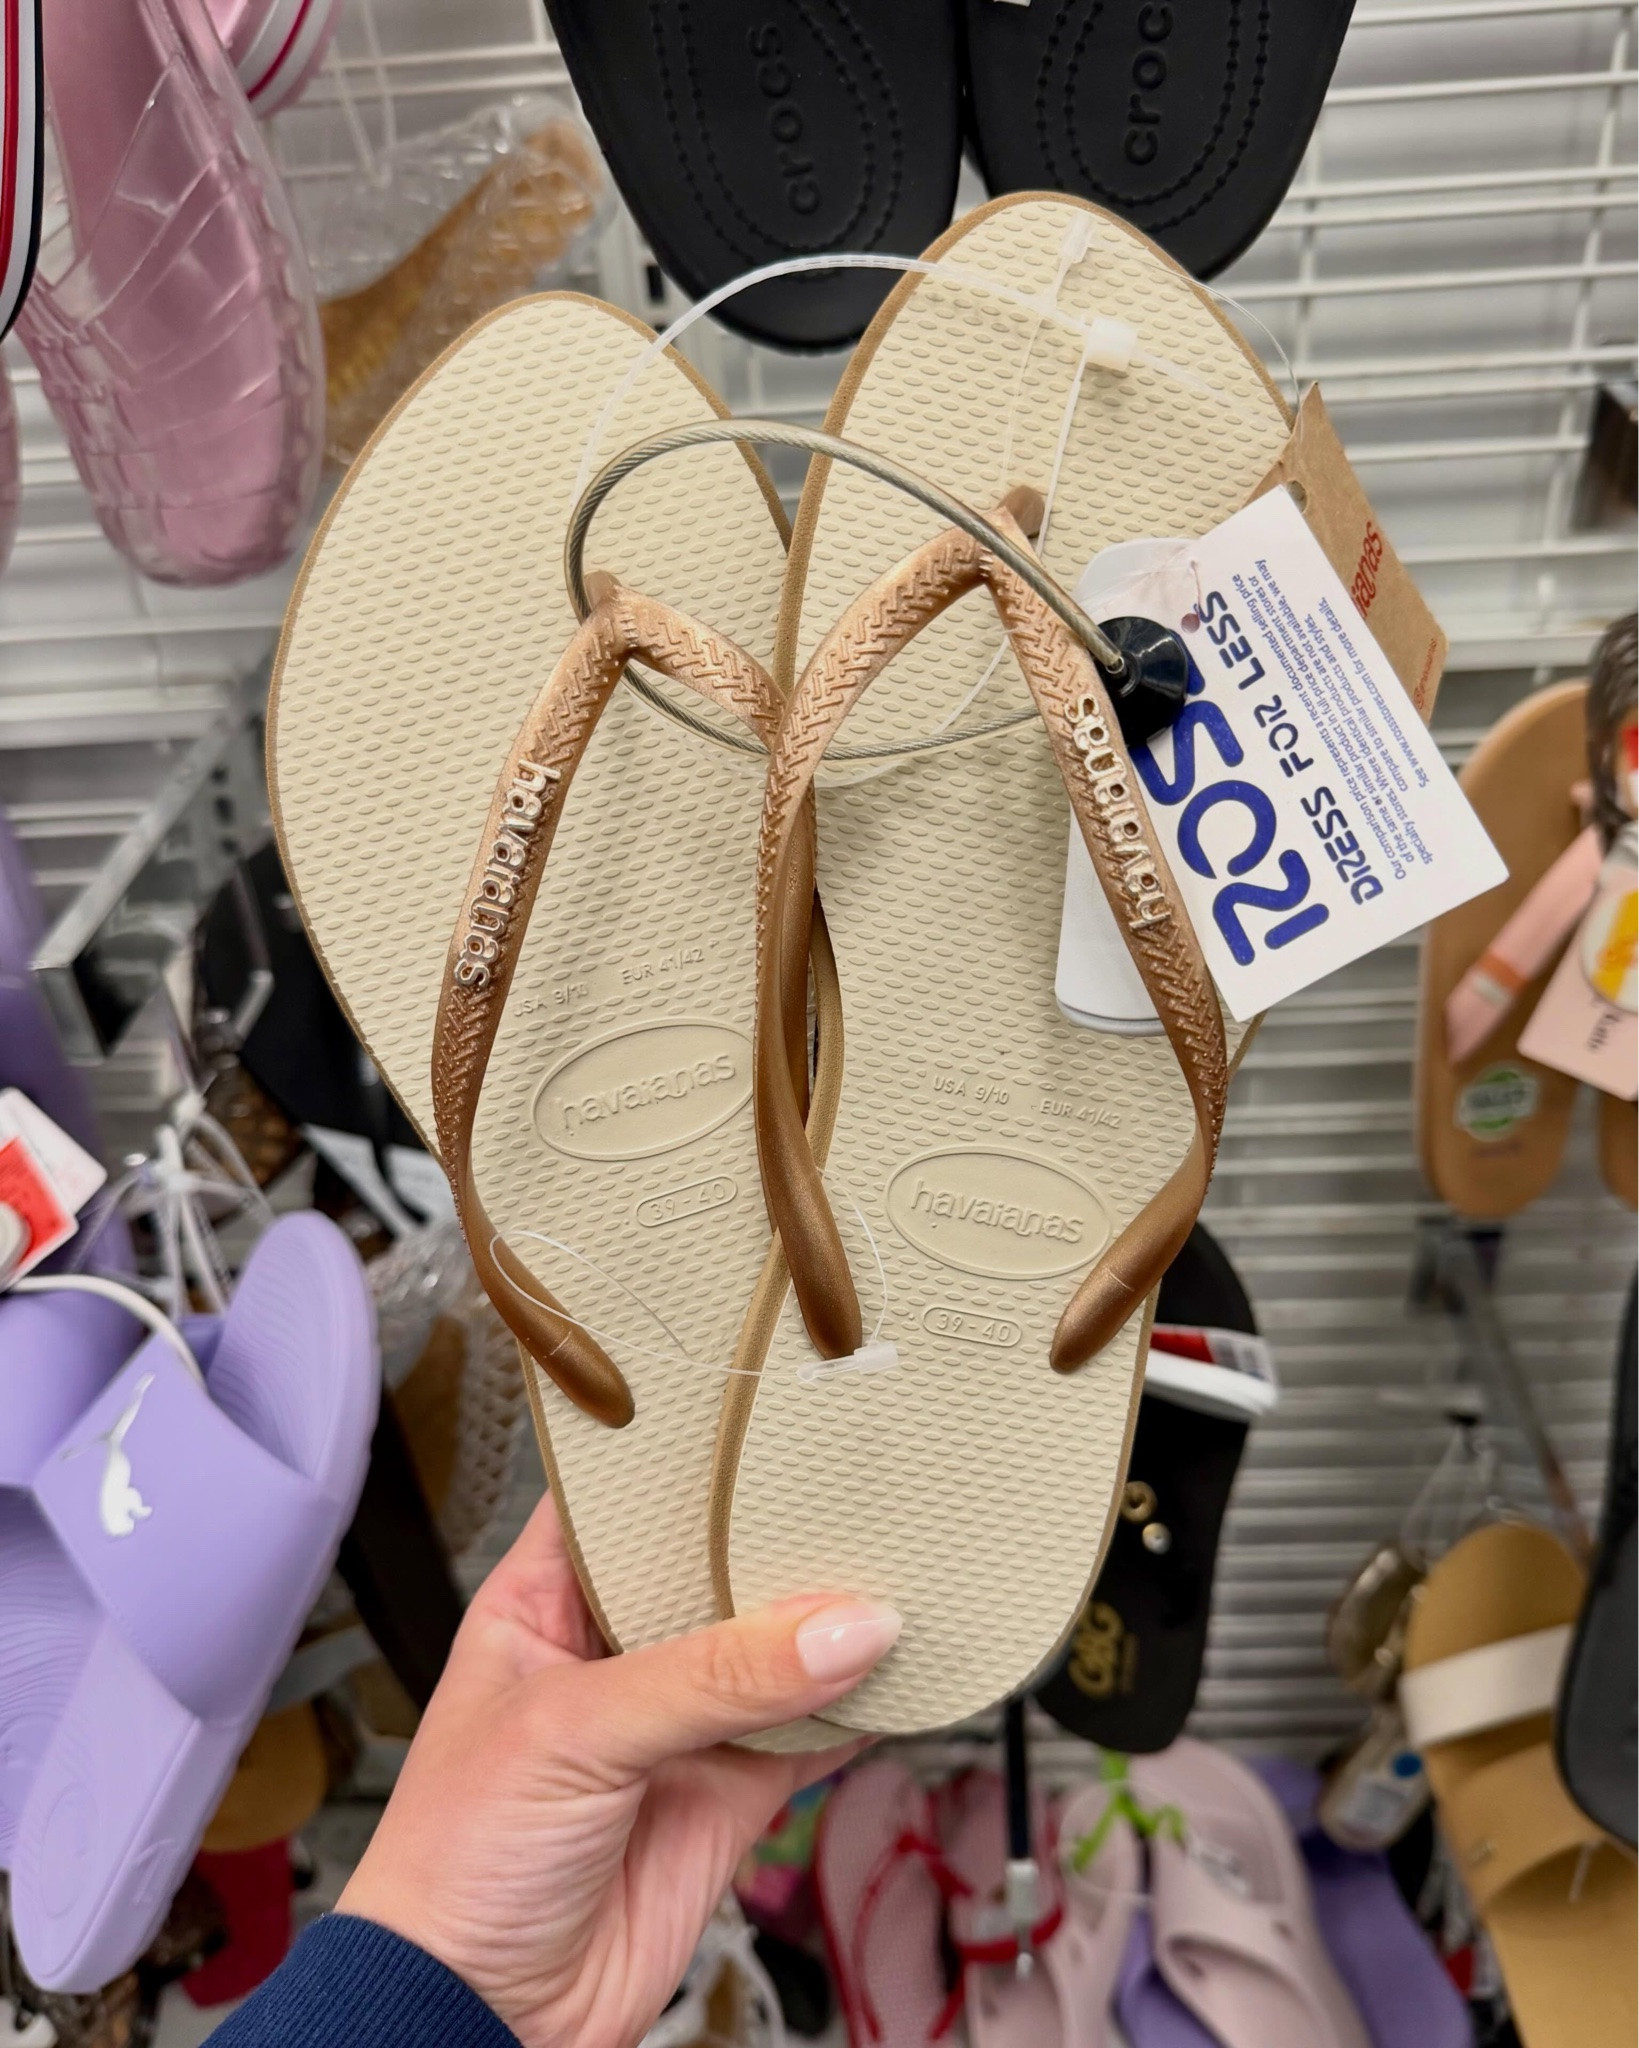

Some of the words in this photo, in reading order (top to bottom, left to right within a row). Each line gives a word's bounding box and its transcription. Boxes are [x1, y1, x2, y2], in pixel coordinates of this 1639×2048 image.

[746, 21, 822, 216] crocs
[1232, 574, 1253, 600] price
[1254, 559, 1272, 582] may
[1267, 580, 1281, 597] we
[1351, 521, 1383, 620] ianas
[1246, 598, 1269, 631] selling
[1255, 586, 1276, 617] stores
[1278, 595, 1307, 641] available,
[1318, 597, 1342, 633] details.
[1198, 591, 1265, 690] LESS
[1271, 616, 1309, 673] department
[1304, 613, 1326, 645] styles.
[1337, 632, 1358, 659] more
[1262, 630, 1303, 691] documented
[1301, 640, 1317, 659] not
[1312, 658, 1327, 676] are
[1318, 643, 1337, 664] and
[1352, 659, 1366, 675] for
[1304, 672, 1332, 715] full-price
[1322, 674, 1351, 717] products
[1332, 664, 1362, 706] products
[1298, 690, 1320, 721] recent
[1356, 706, 1378, 738] similar
[1362, 673, 1418, 768] www.rossstores.com
[1254, 695, 1314, 778] FOR
[1319, 728, 1350, 777] represents
[1332, 724, 1361, 763] product
[1343, 716, 1372, 759] identical
[1346, 777, 1367, 802] price
[1354, 763, 1377, 797] similar
[1368, 757, 1389, 791] Where
[1380, 749, 1408, 792] compare
[1414, 767, 1430, 788] See
[1064, 693, 1172, 929] havaianas
[1128, 628, 1329, 966] ROS
[1386, 788, 1408, 821] stores.
[1360, 802, 1395, 859] comparison
[1378, 806, 1398, 833] same
[1301, 787, 1383, 904] DRESS
[1393, 833, 1408, 852] the
[1404, 821, 1433, 865] specialty
[454, 759, 561, 988] havaianas
[1390, 859, 1407, 880] Our
[621, 963, 655, 985] EUR
[659, 947, 706, 974] 41/42
[555, 1053, 737, 1130] havaianas
[933, 1075, 967, 1097] USA
[974, 1084, 1011, 1106] 9/10
[1039, 1099, 1073, 1119] EUR
[1076, 1104, 1124, 1130] 41/42
[910, 1177, 1085, 1244] havaianas
